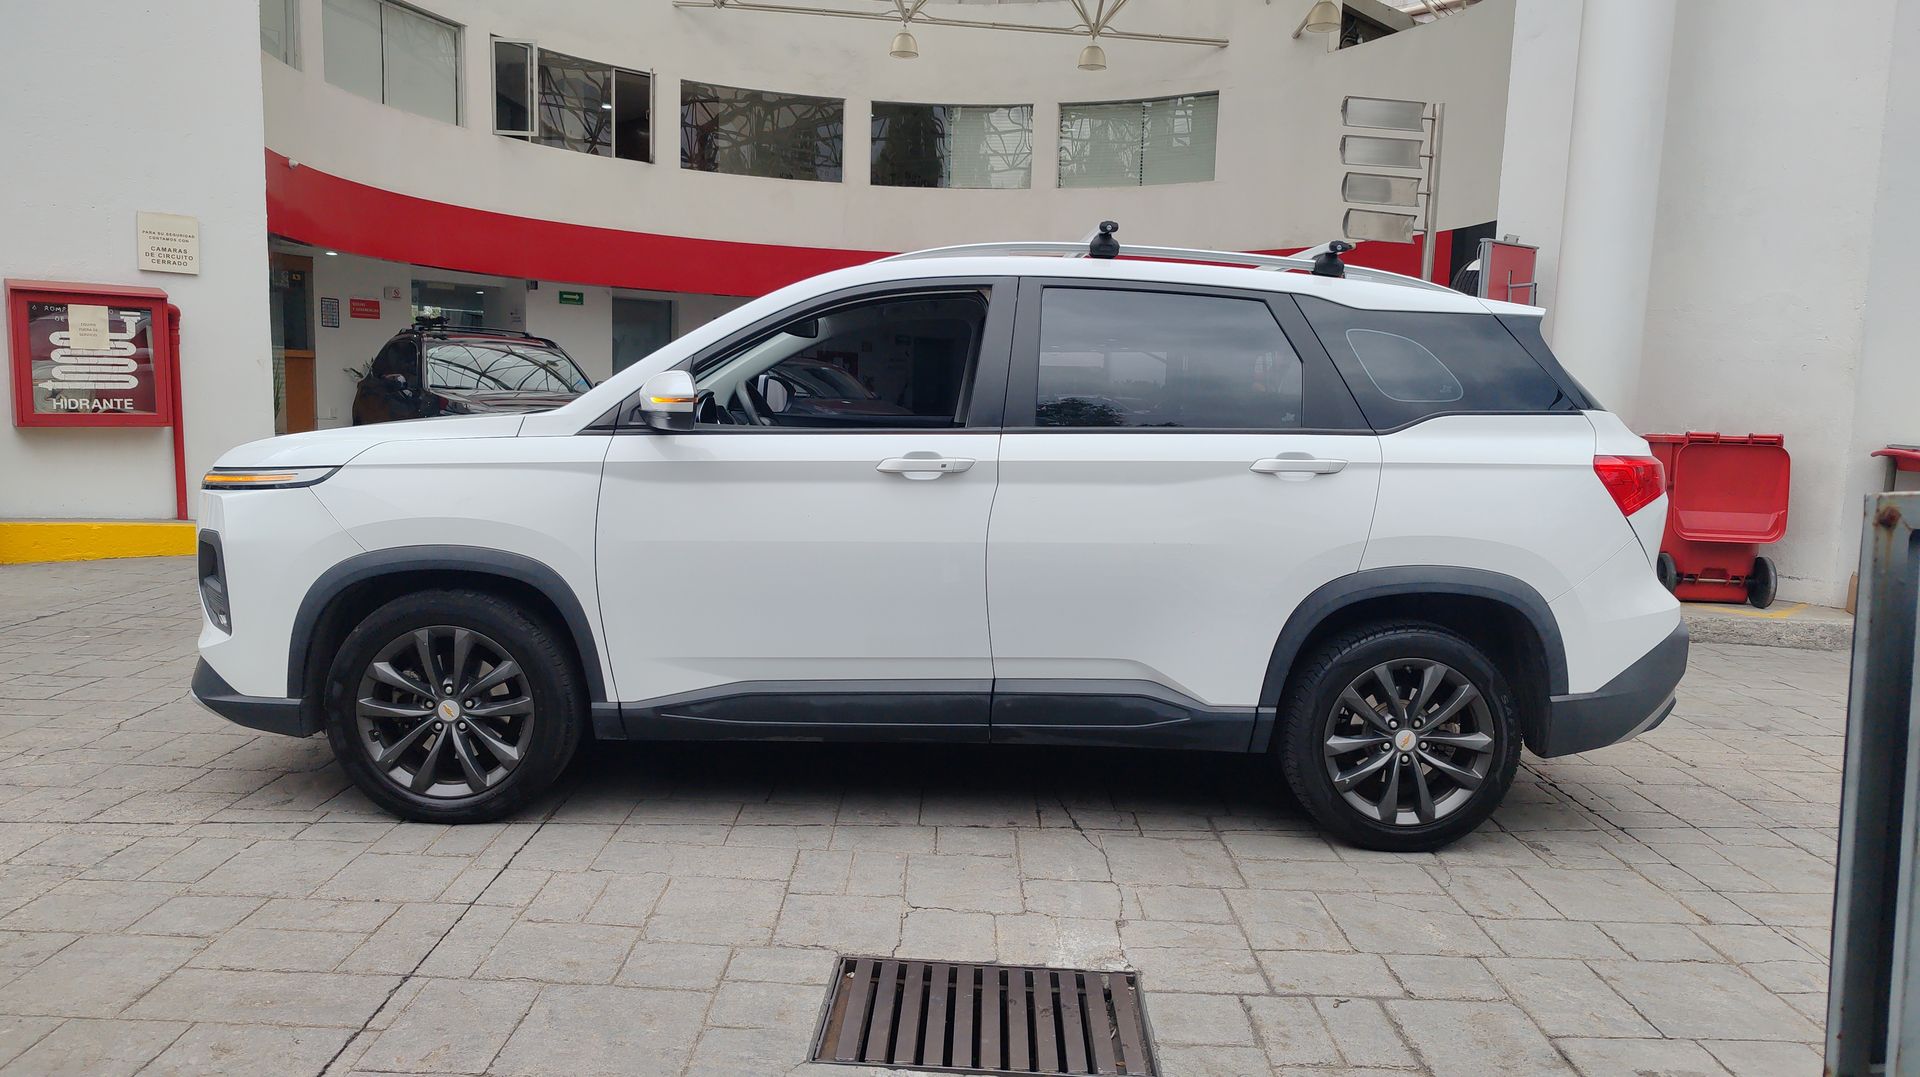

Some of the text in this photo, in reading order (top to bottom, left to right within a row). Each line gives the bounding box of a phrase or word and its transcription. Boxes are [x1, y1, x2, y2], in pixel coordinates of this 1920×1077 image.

[150, 246, 188, 254] CAMARAS
[157, 252, 194, 261] CIRCUITO
[151, 258, 188, 266] CERRADO
[52, 398, 134, 410] HIDRANTE
